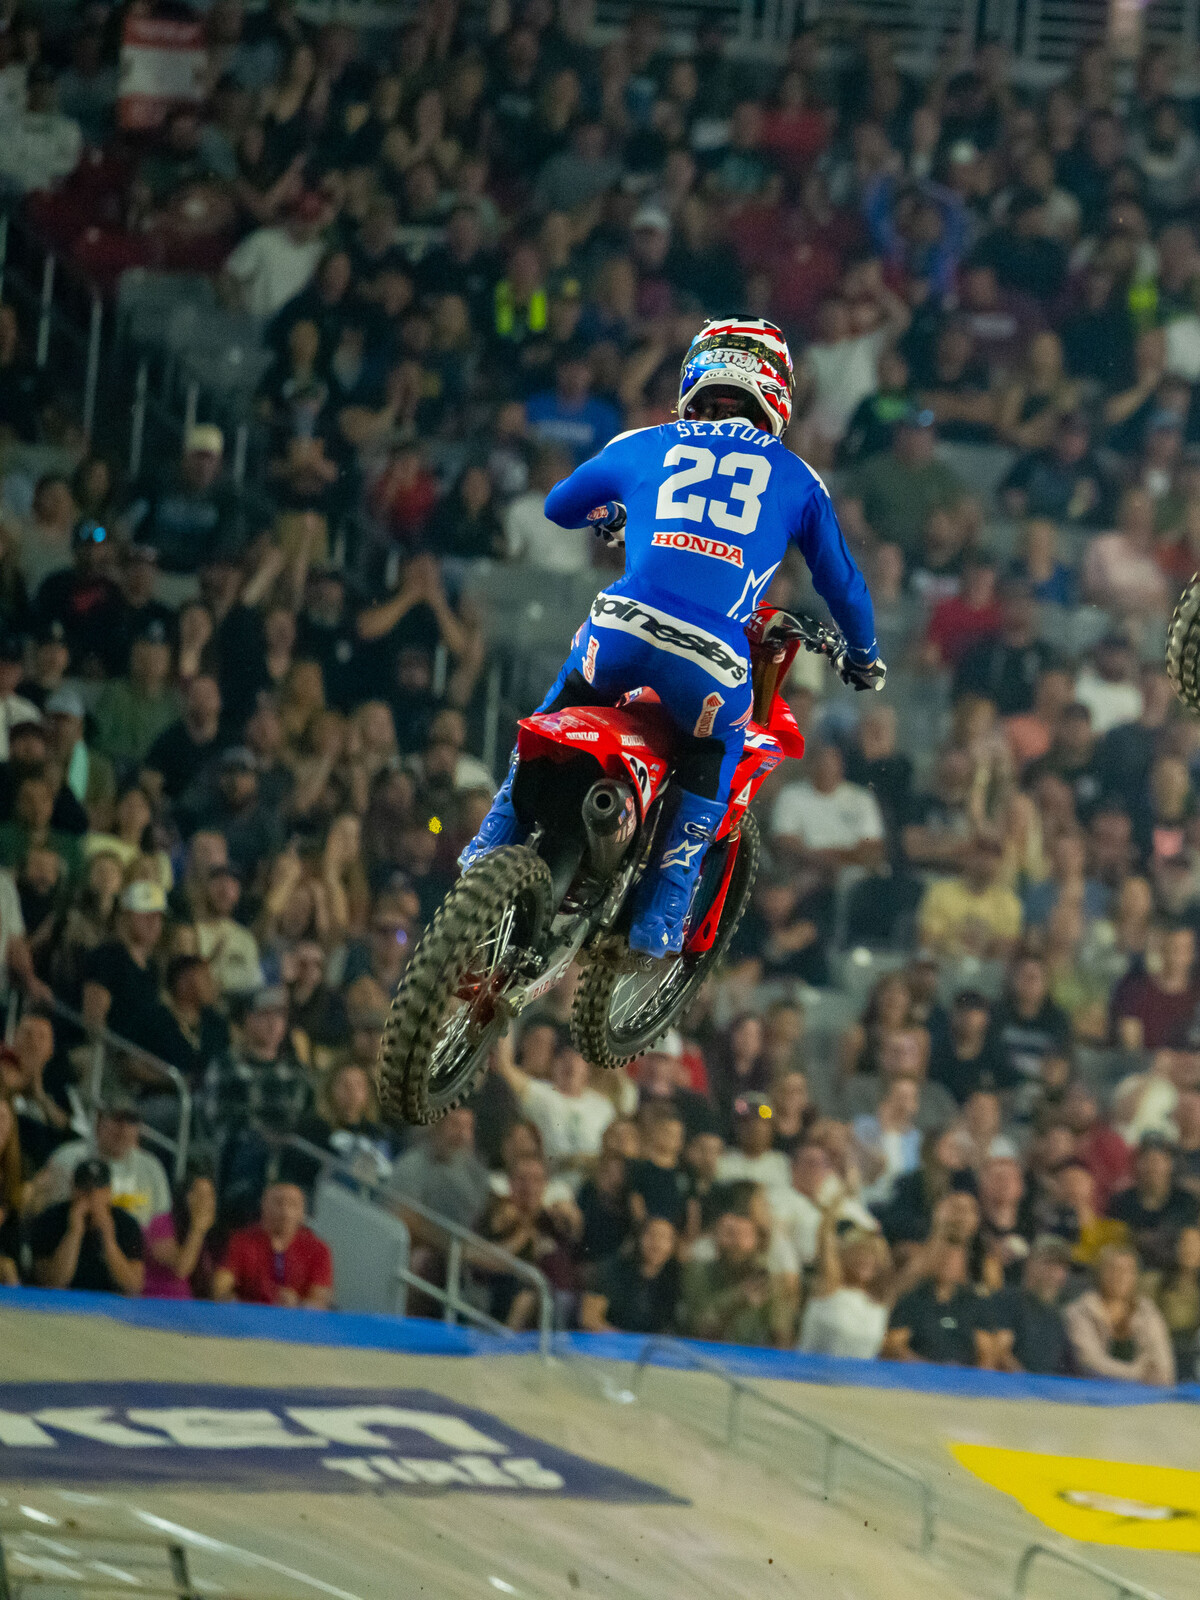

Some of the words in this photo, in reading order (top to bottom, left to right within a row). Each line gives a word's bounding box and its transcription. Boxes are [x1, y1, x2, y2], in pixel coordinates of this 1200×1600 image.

[705, 350, 764, 373] SEXTON
[676, 422, 778, 448] SEXTON
[655, 443, 772, 535] 23
[652, 532, 744, 567] HONDA
[565, 731, 600, 742] DUNLOP
